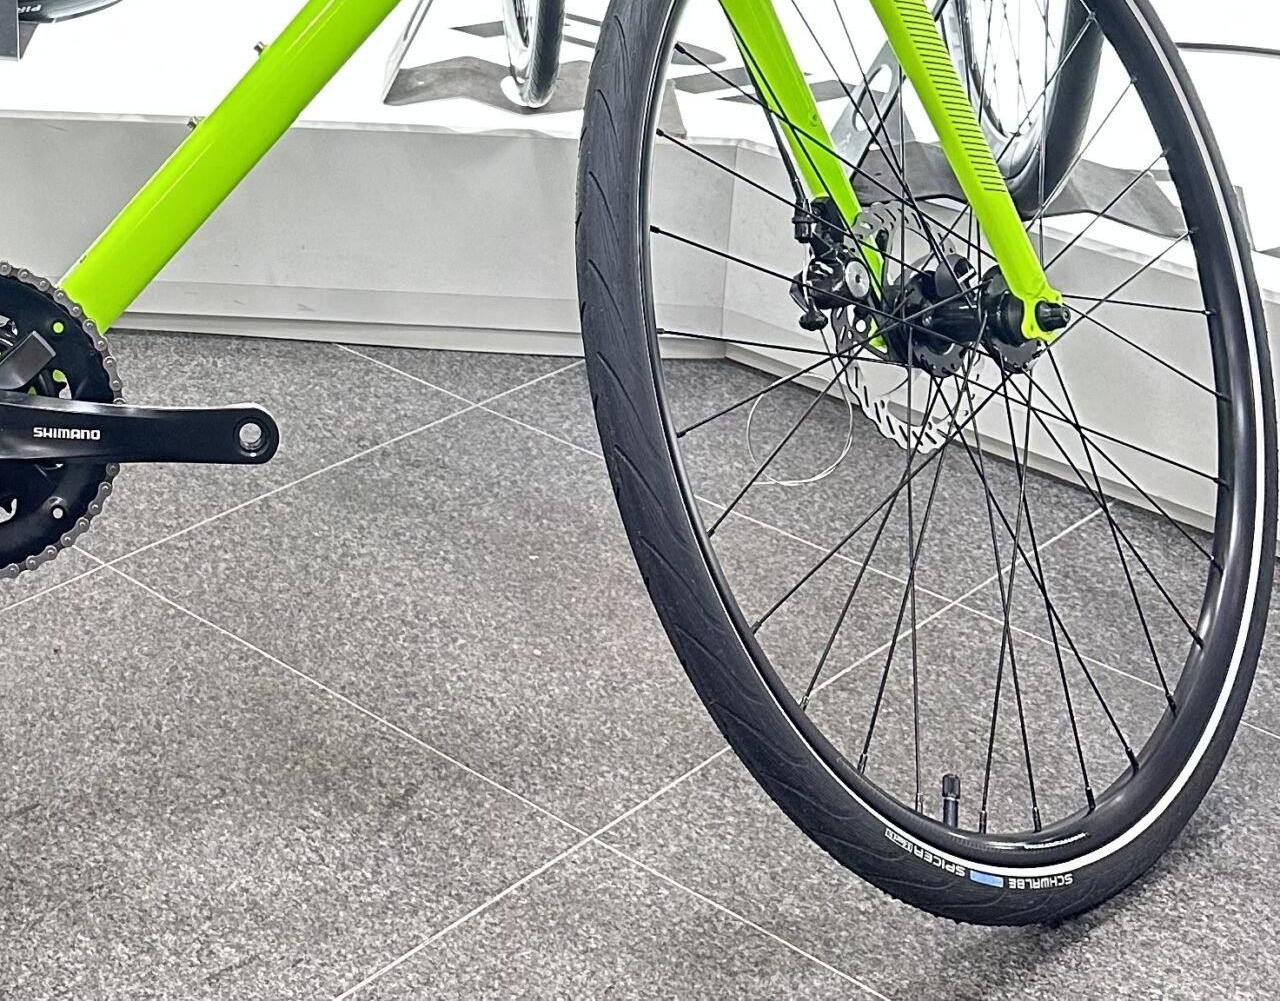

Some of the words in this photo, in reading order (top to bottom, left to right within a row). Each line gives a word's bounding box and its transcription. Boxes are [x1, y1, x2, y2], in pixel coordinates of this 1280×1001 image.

[32, 426, 101, 441] SHIMANO
[911, 848, 966, 878] SPICER
[1008, 873, 1074, 890] SCHWALBE
